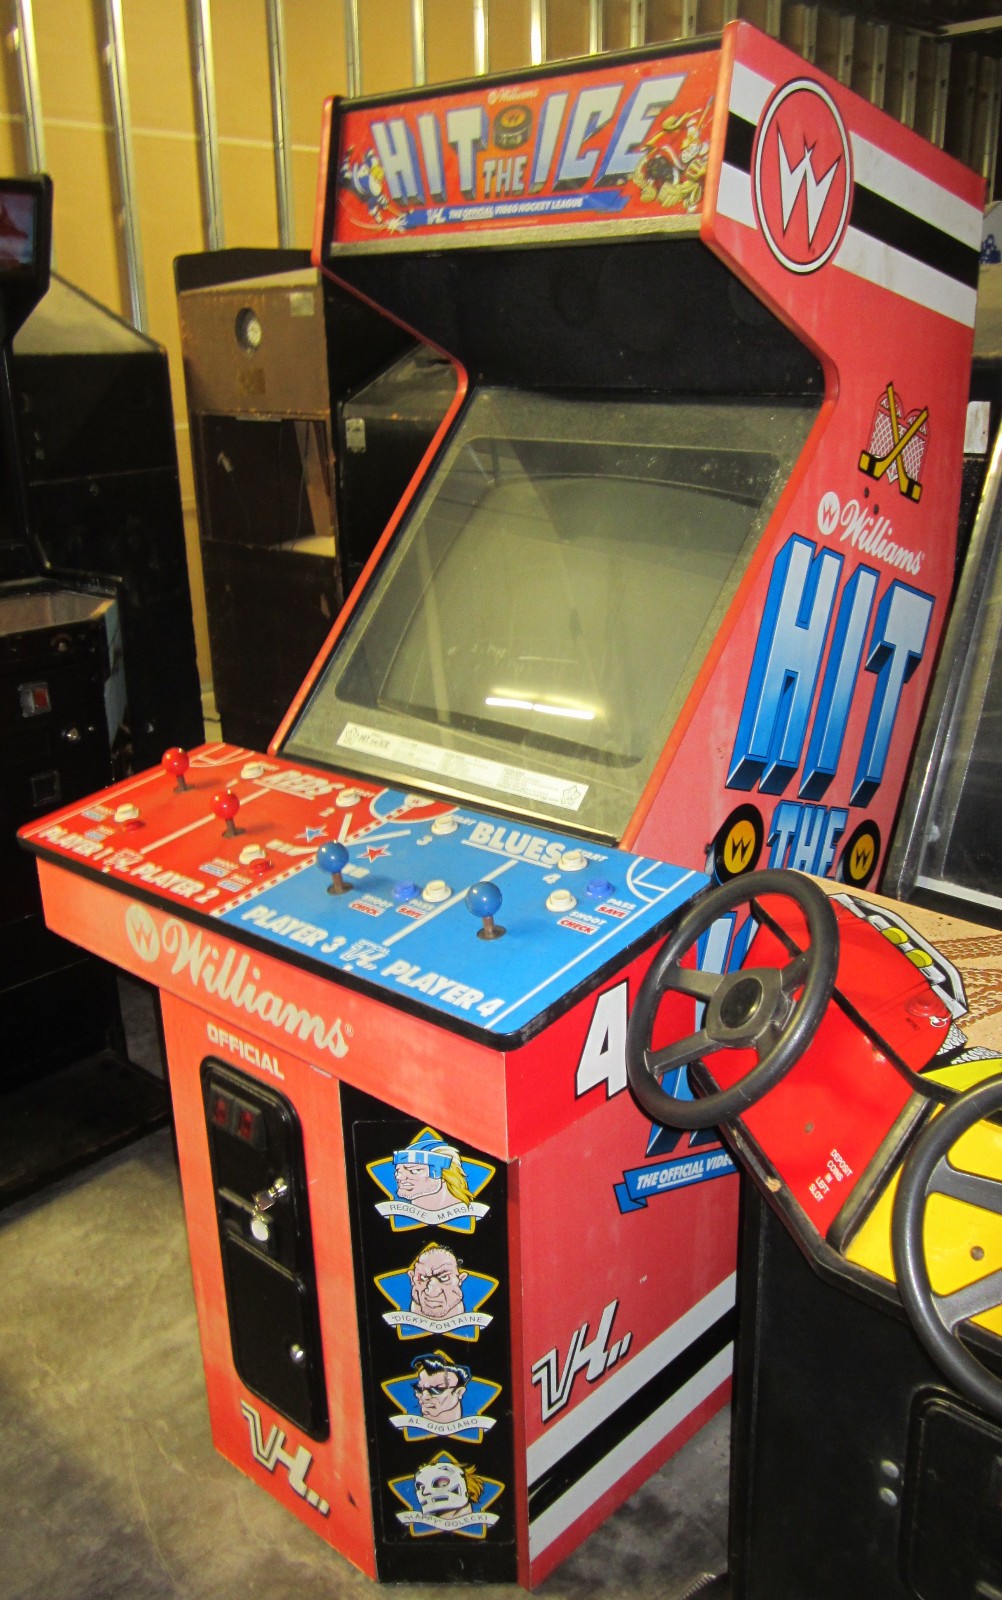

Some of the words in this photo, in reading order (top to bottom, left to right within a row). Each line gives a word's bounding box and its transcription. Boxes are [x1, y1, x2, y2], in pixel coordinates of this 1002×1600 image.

[371, 105, 489, 205] HIT
[483, 155, 528, 198] THE
[530, 72, 687, 191] ICE
[518, 200, 551, 214] HOCKEY
[551, 196, 584, 210] LEAGUE
[840, 499, 922, 576] Williams
[726, 533, 935, 808] HIT
[468, 820, 567, 866] BLUES
[766, 799, 849, 881] THE
[38, 825, 105, 858] PLAYER
[130, 861, 205, 898] PLAYER
[193, 887, 220, 904] 2
[350, 902, 382, 916] CHECK
[597, 905, 627, 918] SAVE
[606, 897, 636, 910] PASS
[559, 918, 594, 934] CHECK
[569, 910, 607, 926] SHOOT
[240, 904, 329, 948] PLAYER
[320, 935, 347, 954] 3
[380, 959, 485, 1010] PLAYER
[476, 998, 506, 1018] 4
[162, 917, 349, 1059] Williams
[575, 977, 629, 1101] 4
[206, 1021, 285, 1081] OFFICIAL
[826, 1160, 844, 1182] COINS
[830, 1148, 853, 1177] DEPOSIT
[636, 1170, 660, 1190] THE
[659, 1159, 704, 1185] OFFICIAL
[815, 1176, 830, 1194] LEFT
[808, 1183, 824, 1202] SLOT
[390, 1203, 428, 1219] REGGIE
[437, 1204, 474, 1221] MARSH
[429, 1316, 482, 1330] FONTAINE
[408, 1417, 421, 1425] AL
[427, 1418, 478, 1432] GIGLIANO
[444, 1514, 488, 1528] GOLECKI
